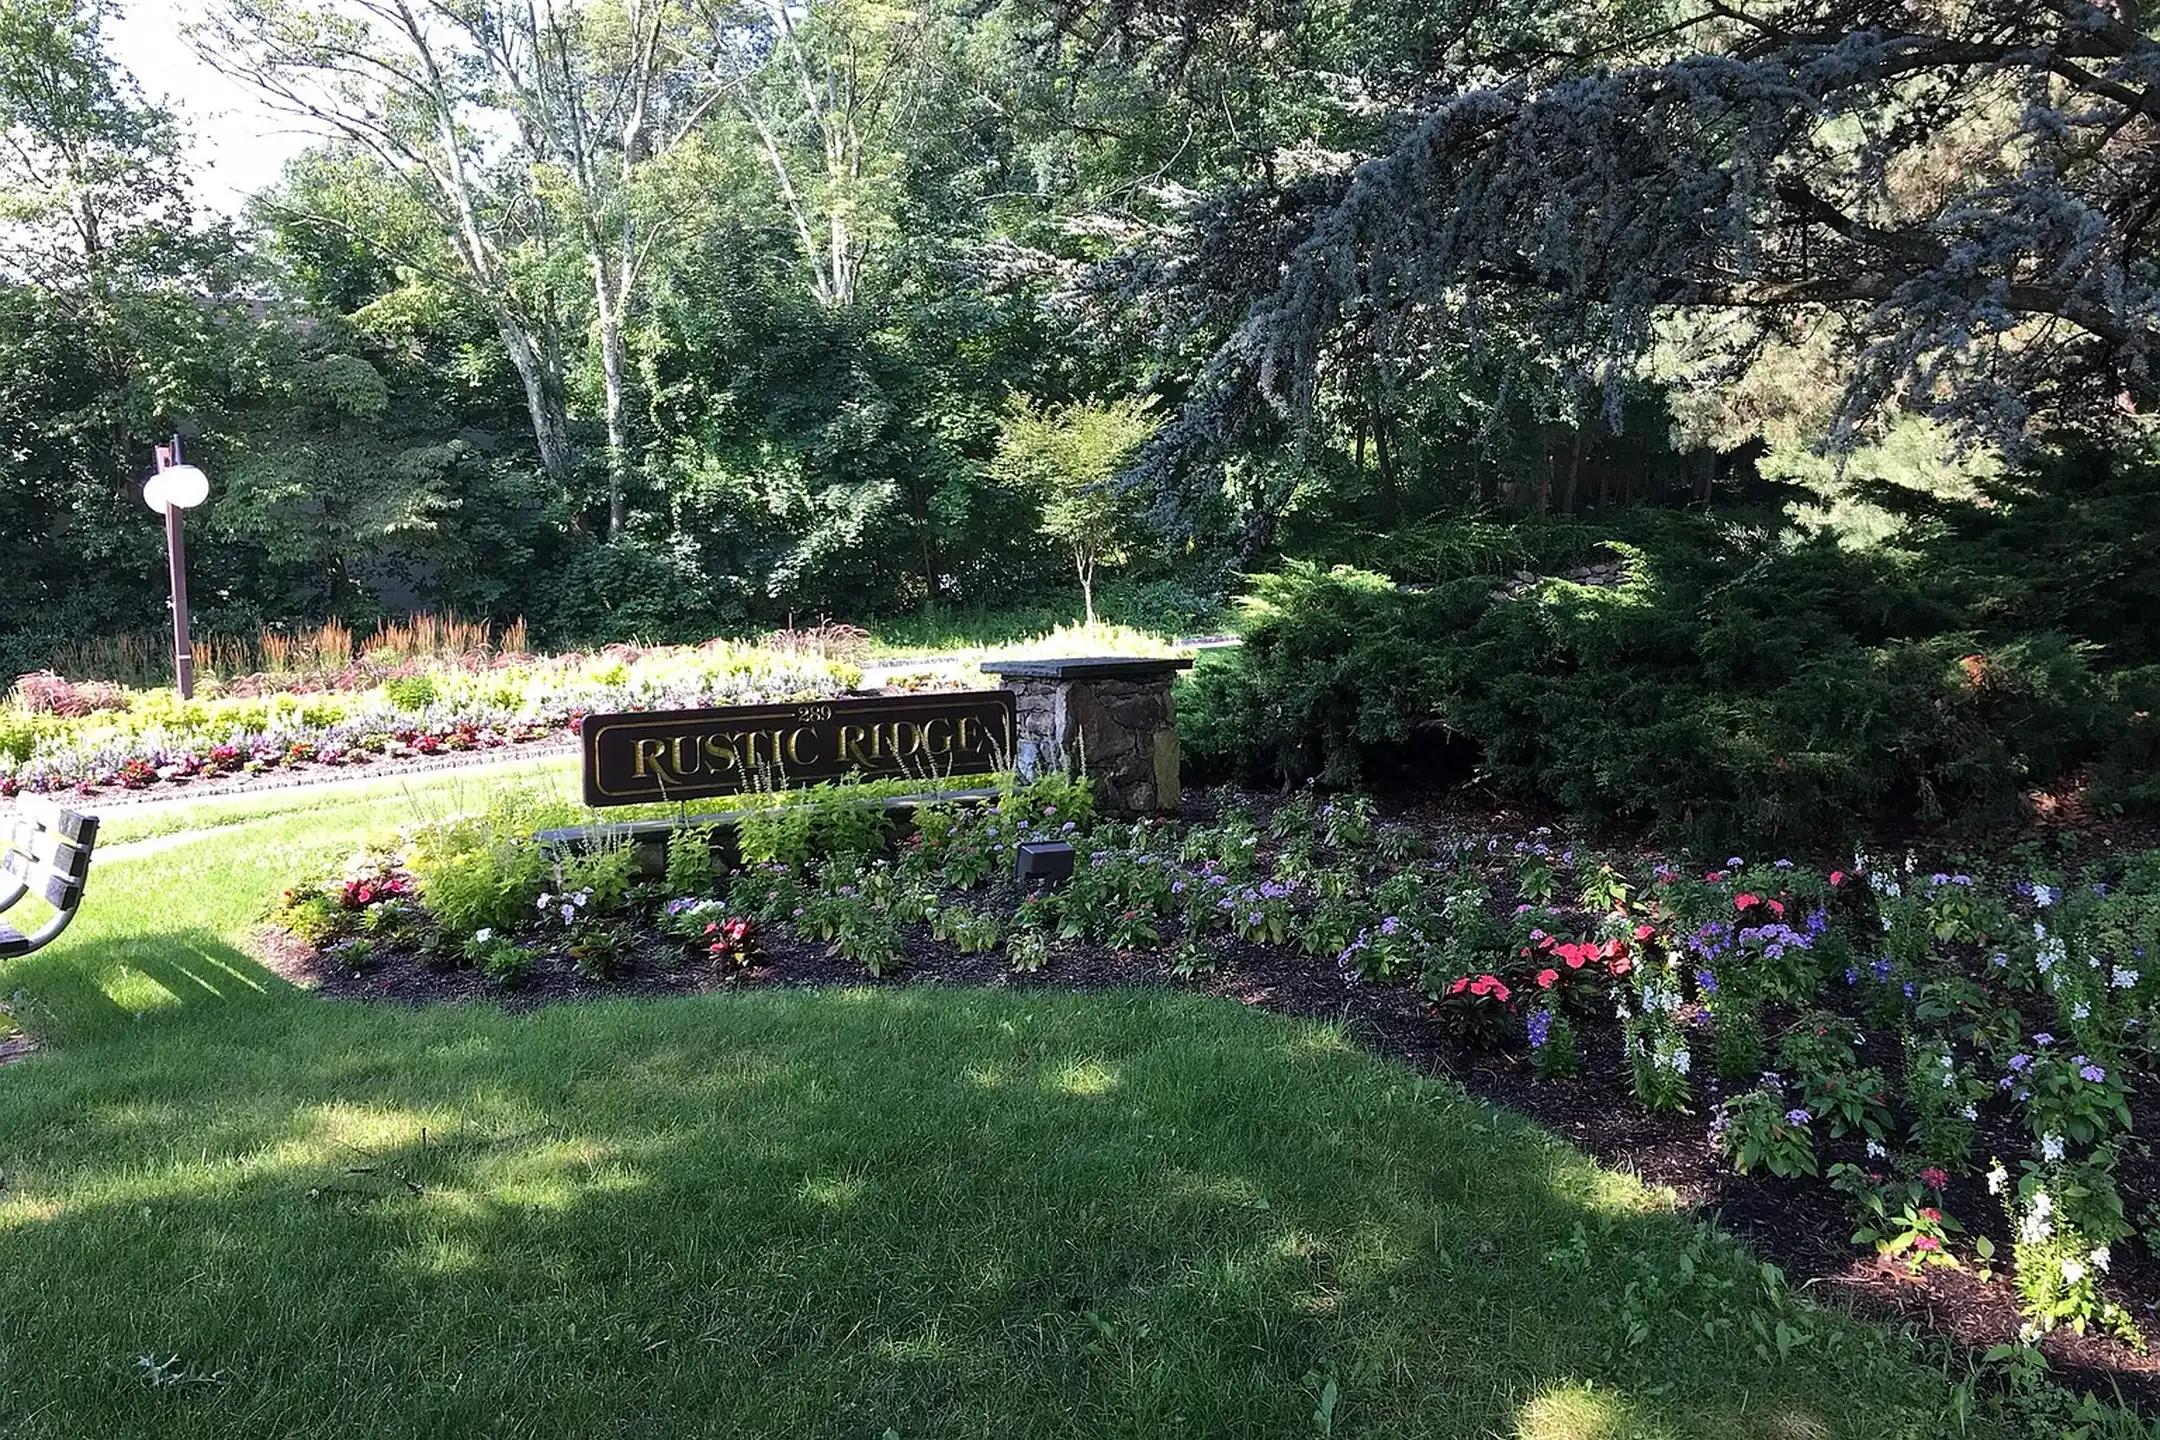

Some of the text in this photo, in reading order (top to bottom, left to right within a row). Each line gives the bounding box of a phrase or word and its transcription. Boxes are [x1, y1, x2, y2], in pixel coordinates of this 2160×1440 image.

[798, 704, 832, 722] 289
[630, 715, 984, 785] RUSTIC RIDGE
